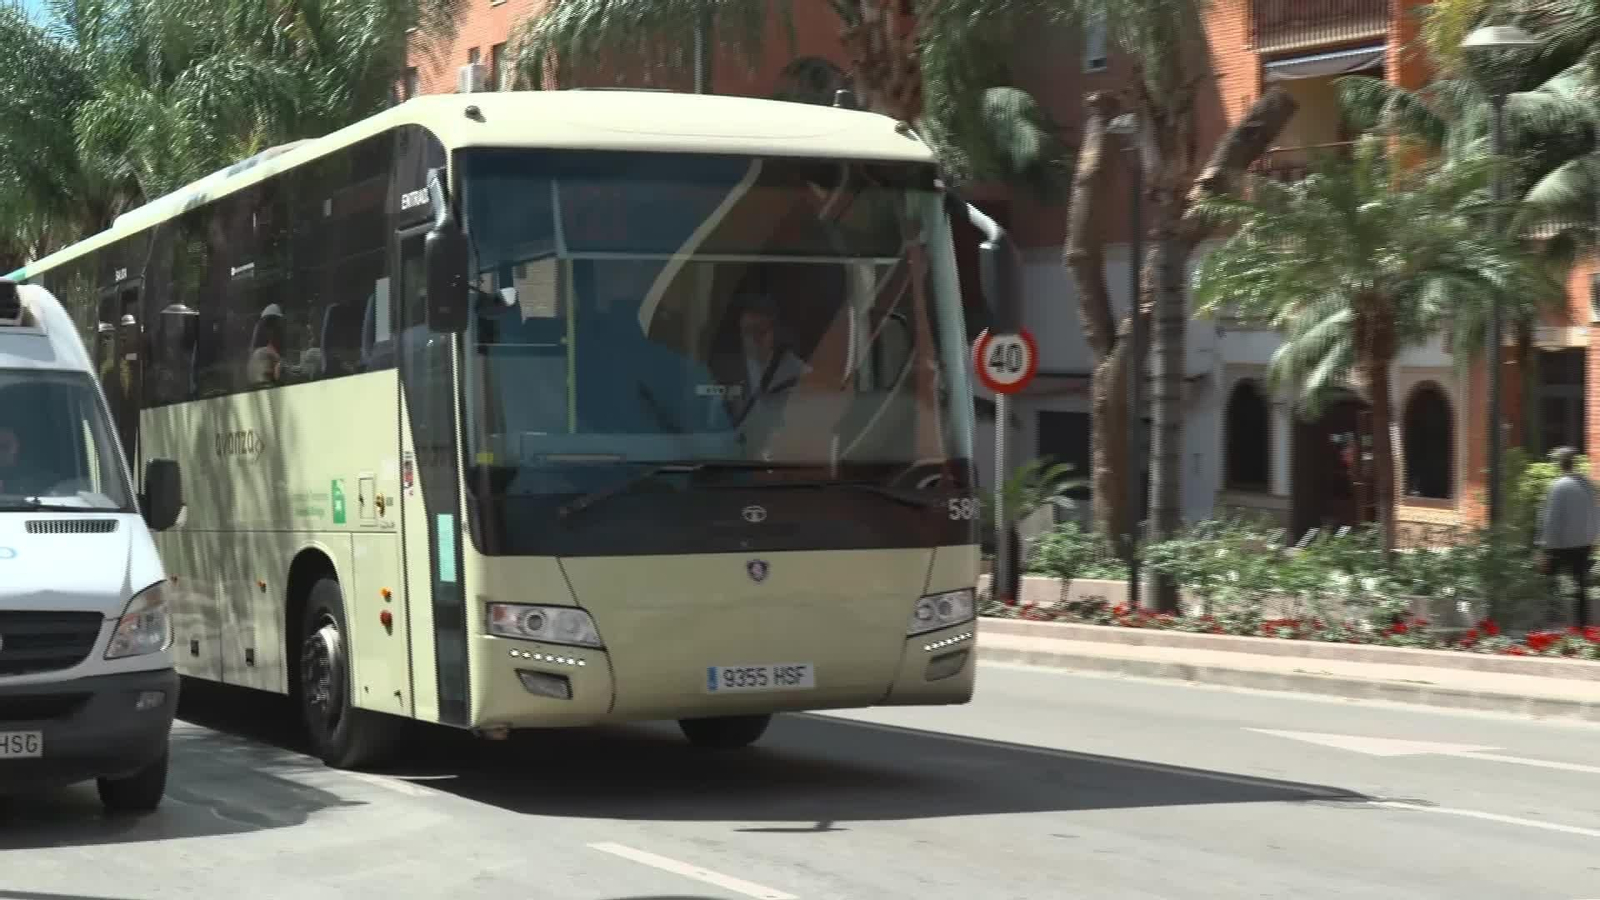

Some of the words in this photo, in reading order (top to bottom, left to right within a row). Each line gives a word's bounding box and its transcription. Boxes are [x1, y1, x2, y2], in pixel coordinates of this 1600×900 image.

[989, 343, 1022, 373] 40
[215, 429, 255, 457] avanza
[723, 667, 767, 687] 9355
[773, 665, 806, 686] HSF
